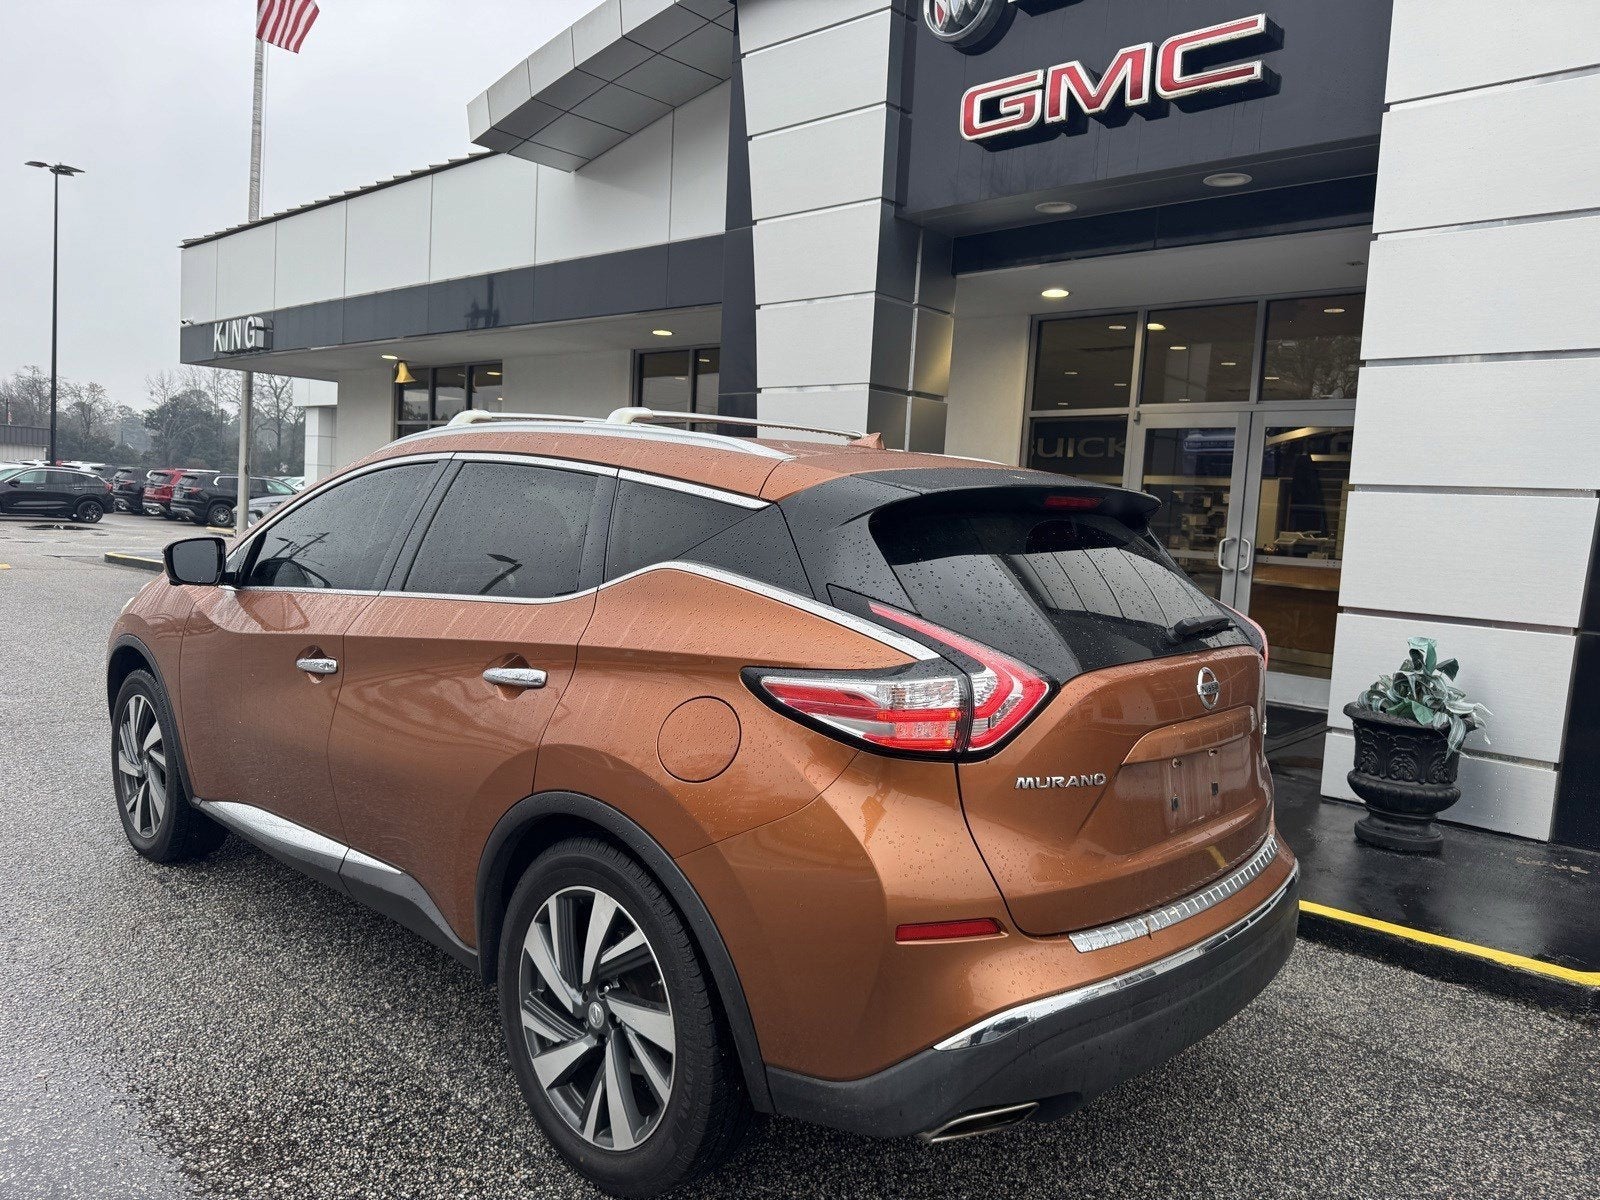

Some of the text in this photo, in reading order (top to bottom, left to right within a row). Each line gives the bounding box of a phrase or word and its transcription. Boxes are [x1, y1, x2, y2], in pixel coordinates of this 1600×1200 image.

[960, 12, 1266, 141] GMC
[213, 315, 258, 352] KING
[1030, 436, 1125, 459] UICK
[1014, 772, 1107, 790] MURANO
